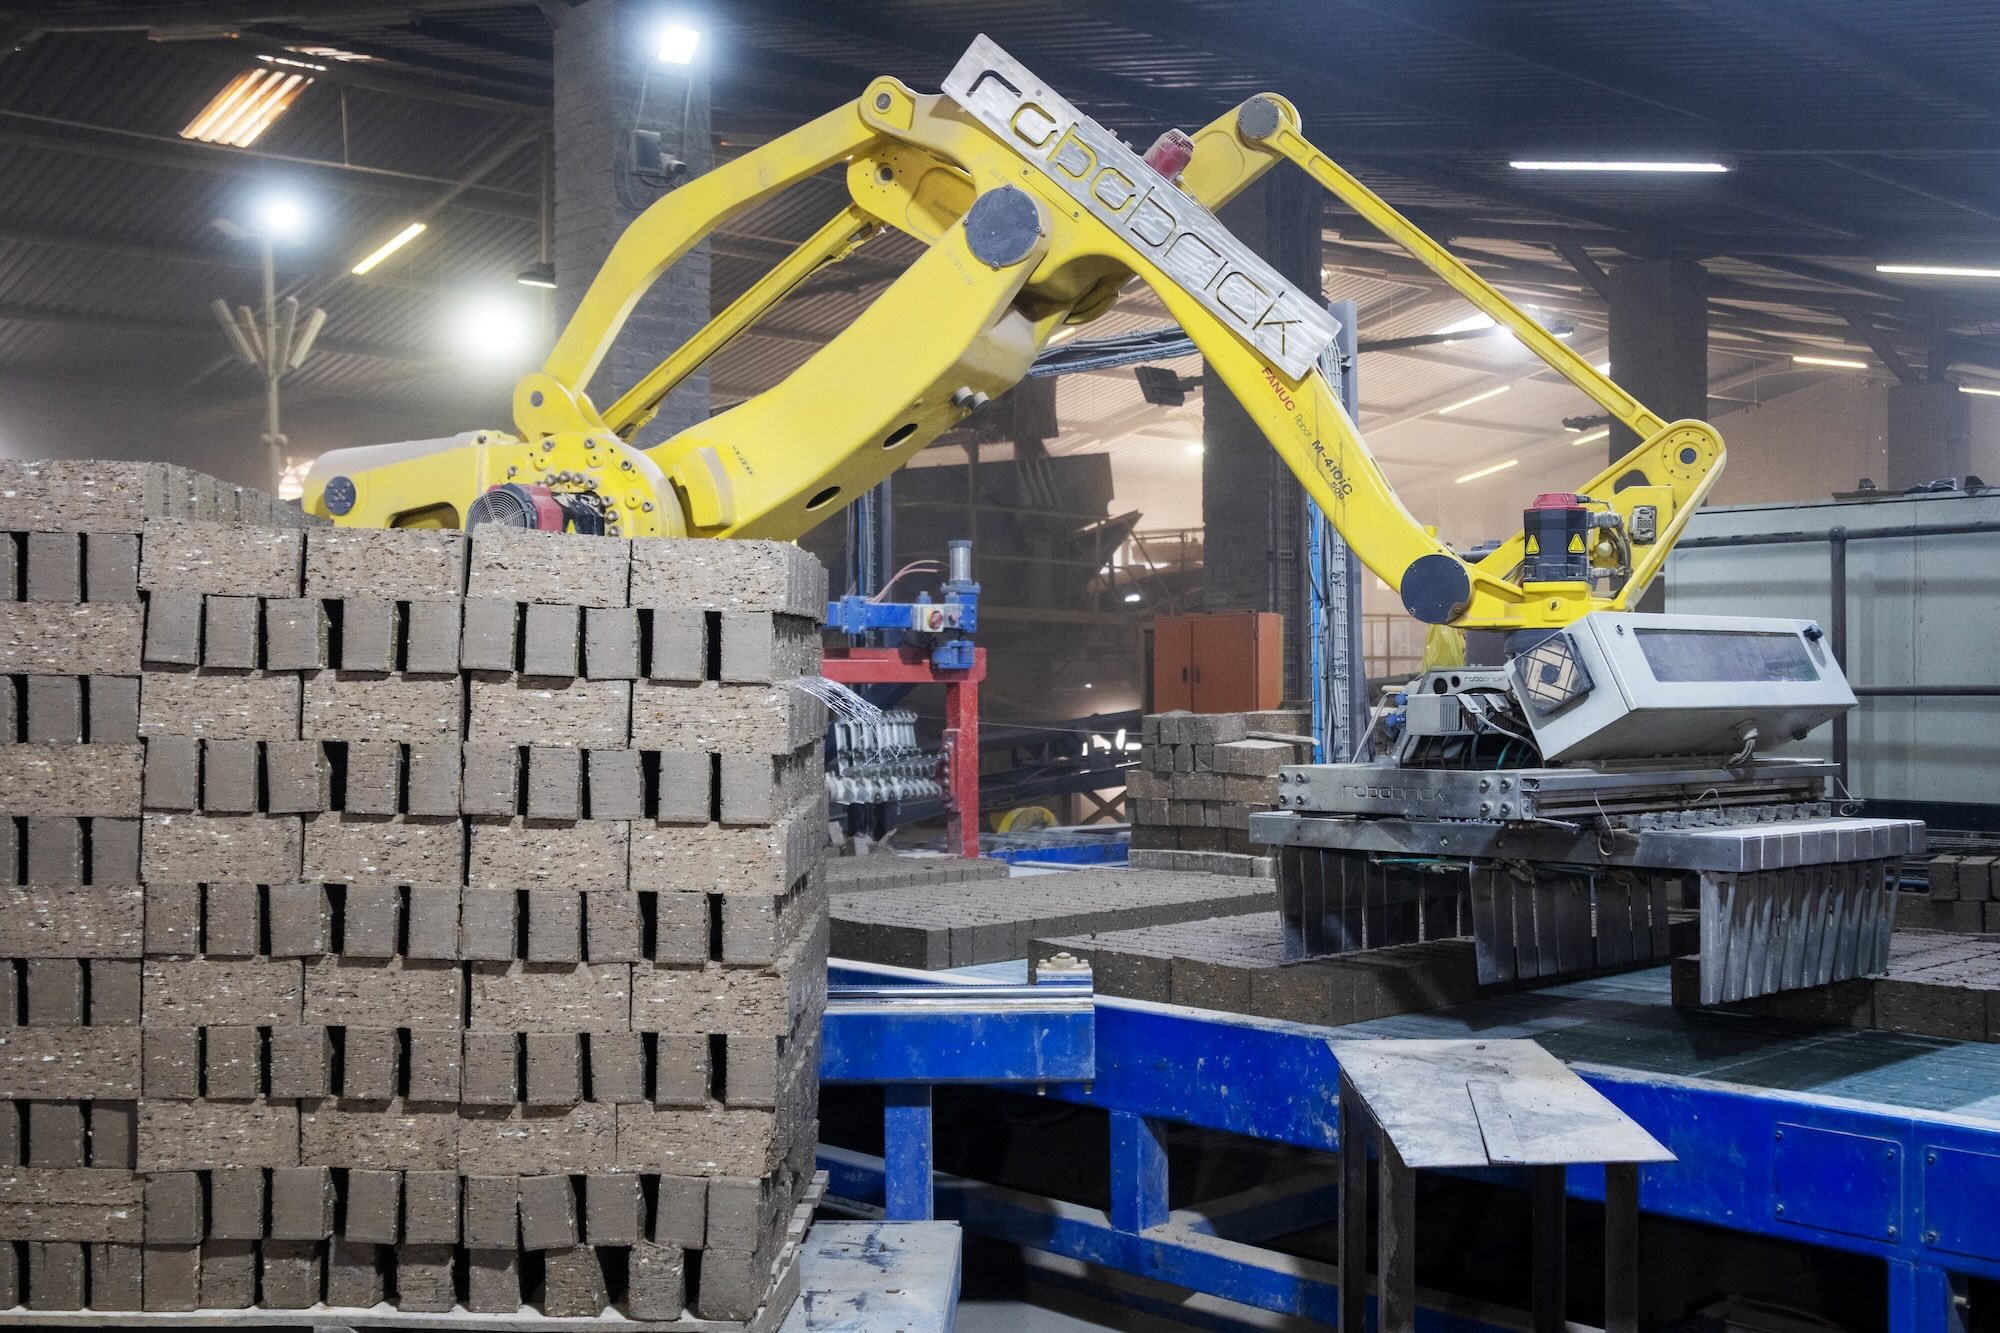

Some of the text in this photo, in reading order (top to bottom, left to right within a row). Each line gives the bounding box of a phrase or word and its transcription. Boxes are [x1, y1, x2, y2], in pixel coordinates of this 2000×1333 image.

[966, 69, 1303, 355] robobrick
[1262, 367, 1295, 412] FANUC
[1342, 784, 1445, 801] robobrick
